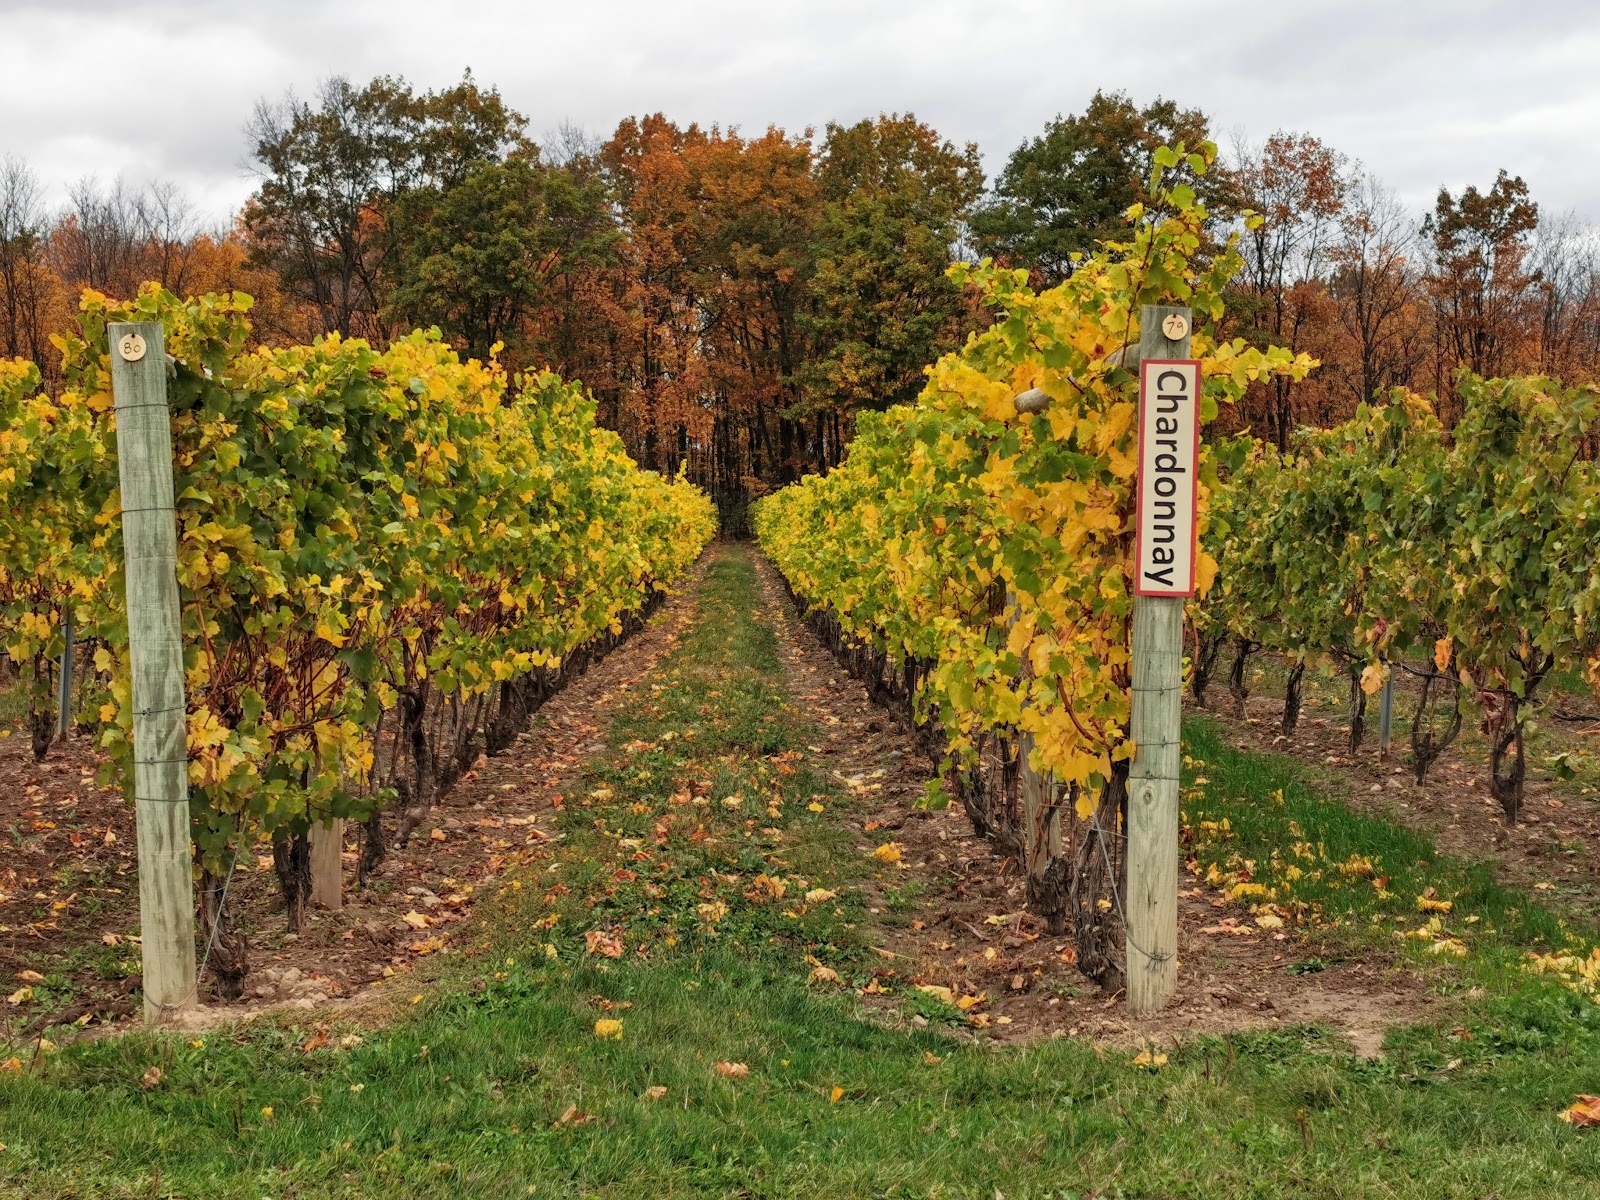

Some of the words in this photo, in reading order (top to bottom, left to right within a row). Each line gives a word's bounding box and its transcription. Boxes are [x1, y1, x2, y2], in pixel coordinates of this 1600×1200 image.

[1167, 321, 1184, 334] 79
[123, 342, 141, 355] 80
[1144, 370, 1188, 587] Chardonnay
